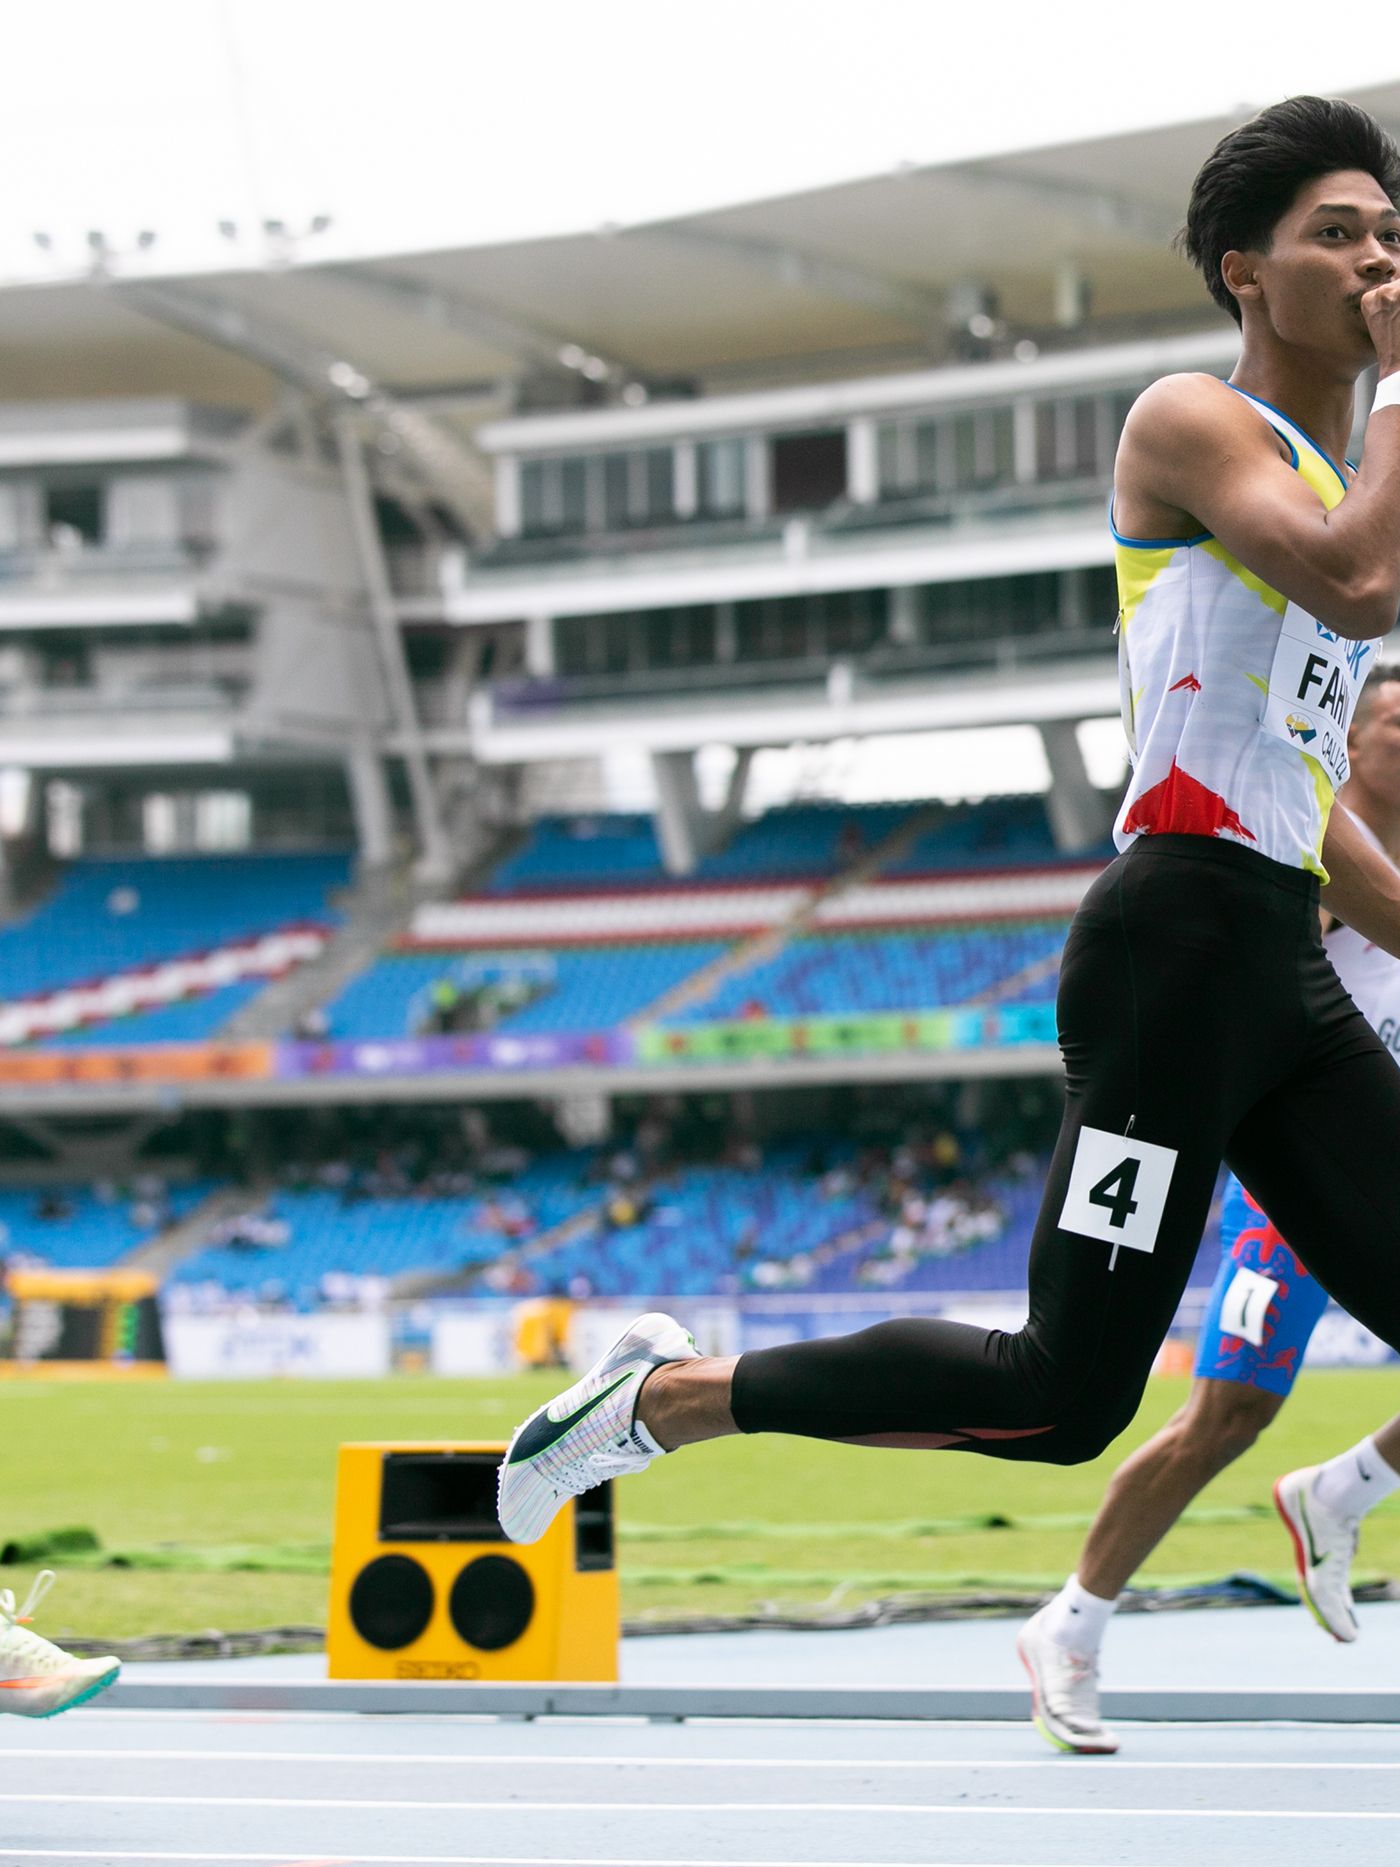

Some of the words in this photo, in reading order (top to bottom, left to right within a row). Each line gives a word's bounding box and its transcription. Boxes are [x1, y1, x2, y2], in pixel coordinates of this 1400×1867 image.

[1322, 731, 1341, 769] CALI
[1089, 1157, 1141, 1229] 4
[1241, 1288, 1254, 1328] 1
